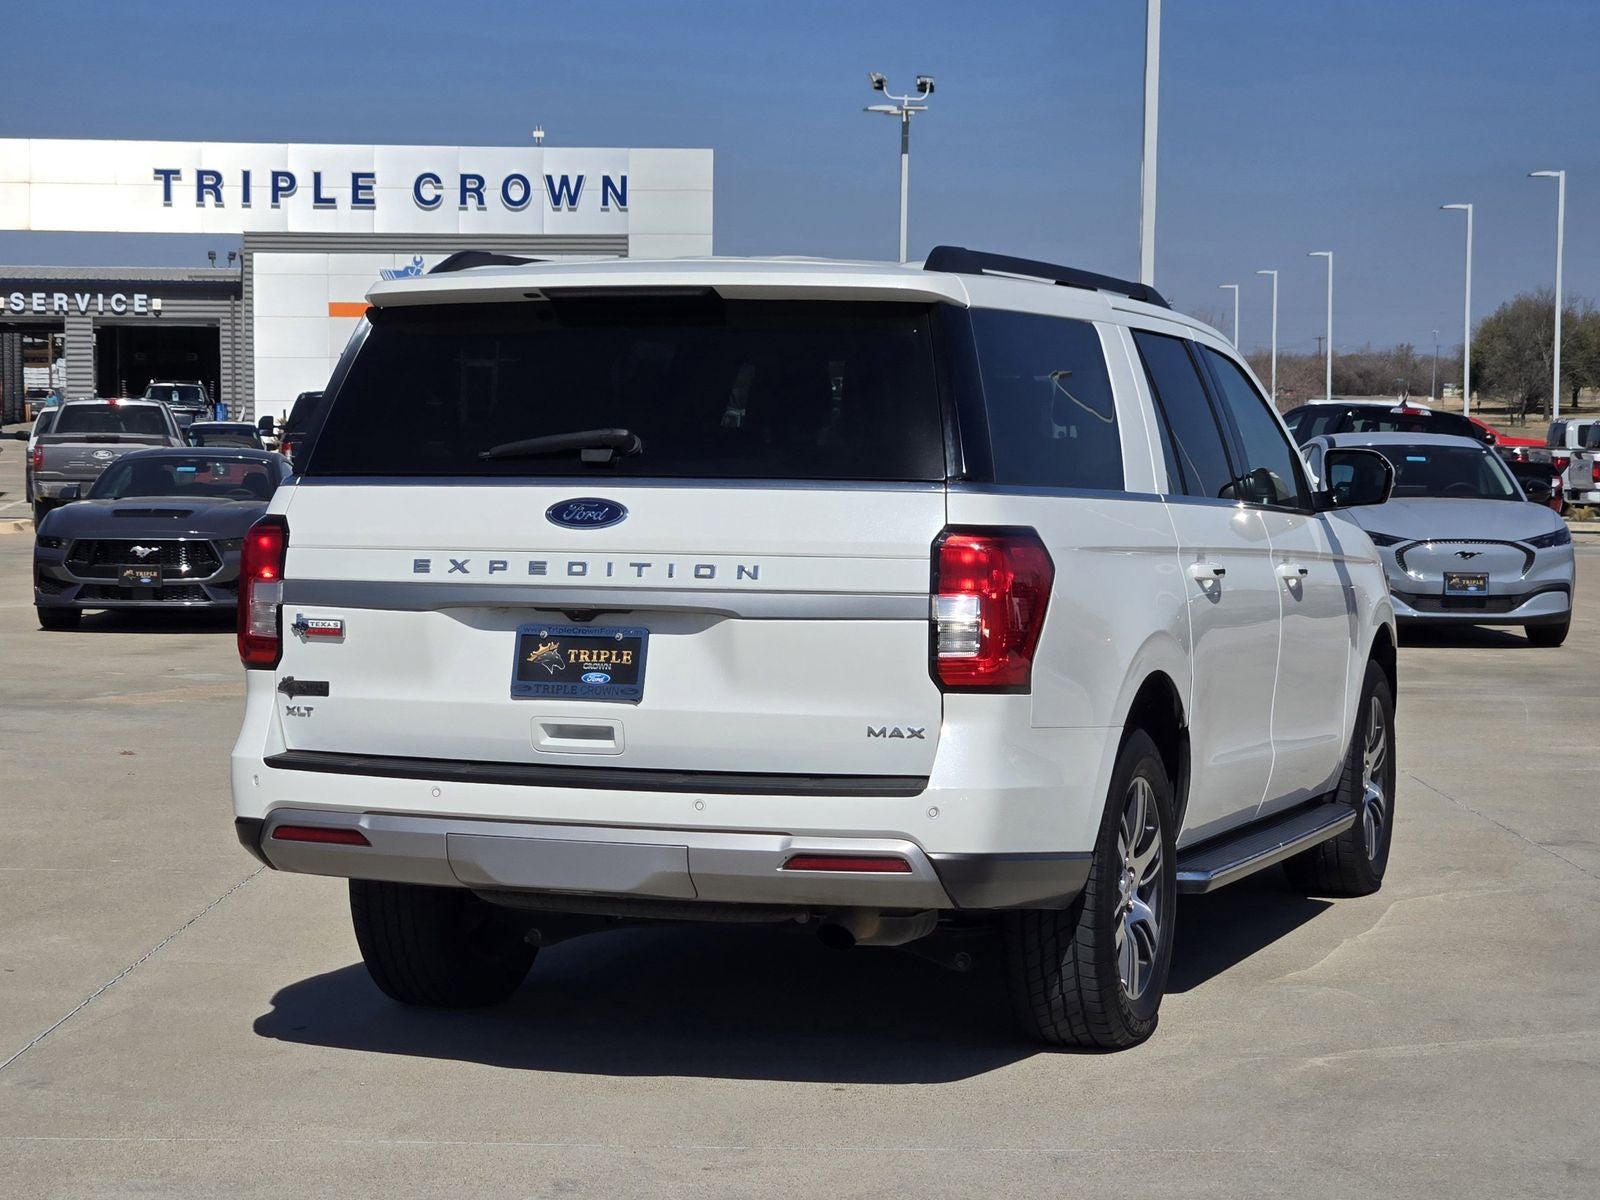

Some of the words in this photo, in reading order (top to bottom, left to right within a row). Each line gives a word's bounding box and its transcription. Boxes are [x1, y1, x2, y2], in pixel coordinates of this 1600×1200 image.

[153, 168, 377, 207] TRIPLE
[412, 172, 629, 211] CROWN
[9, 292, 149, 313] SERVICE
[412, 558, 759, 581] EXPEDITION
[523, 626, 643, 636] wwwTripleCrownFord.com
[567, 649, 633, 665] TRIPLE
[583, 662, 612, 671] CROWN
[534, 683, 578, 695] TRIPLE
[579, 685, 620, 697] CROWN
[286, 705, 314, 718] XLT
[867, 726, 925, 739] MAX
